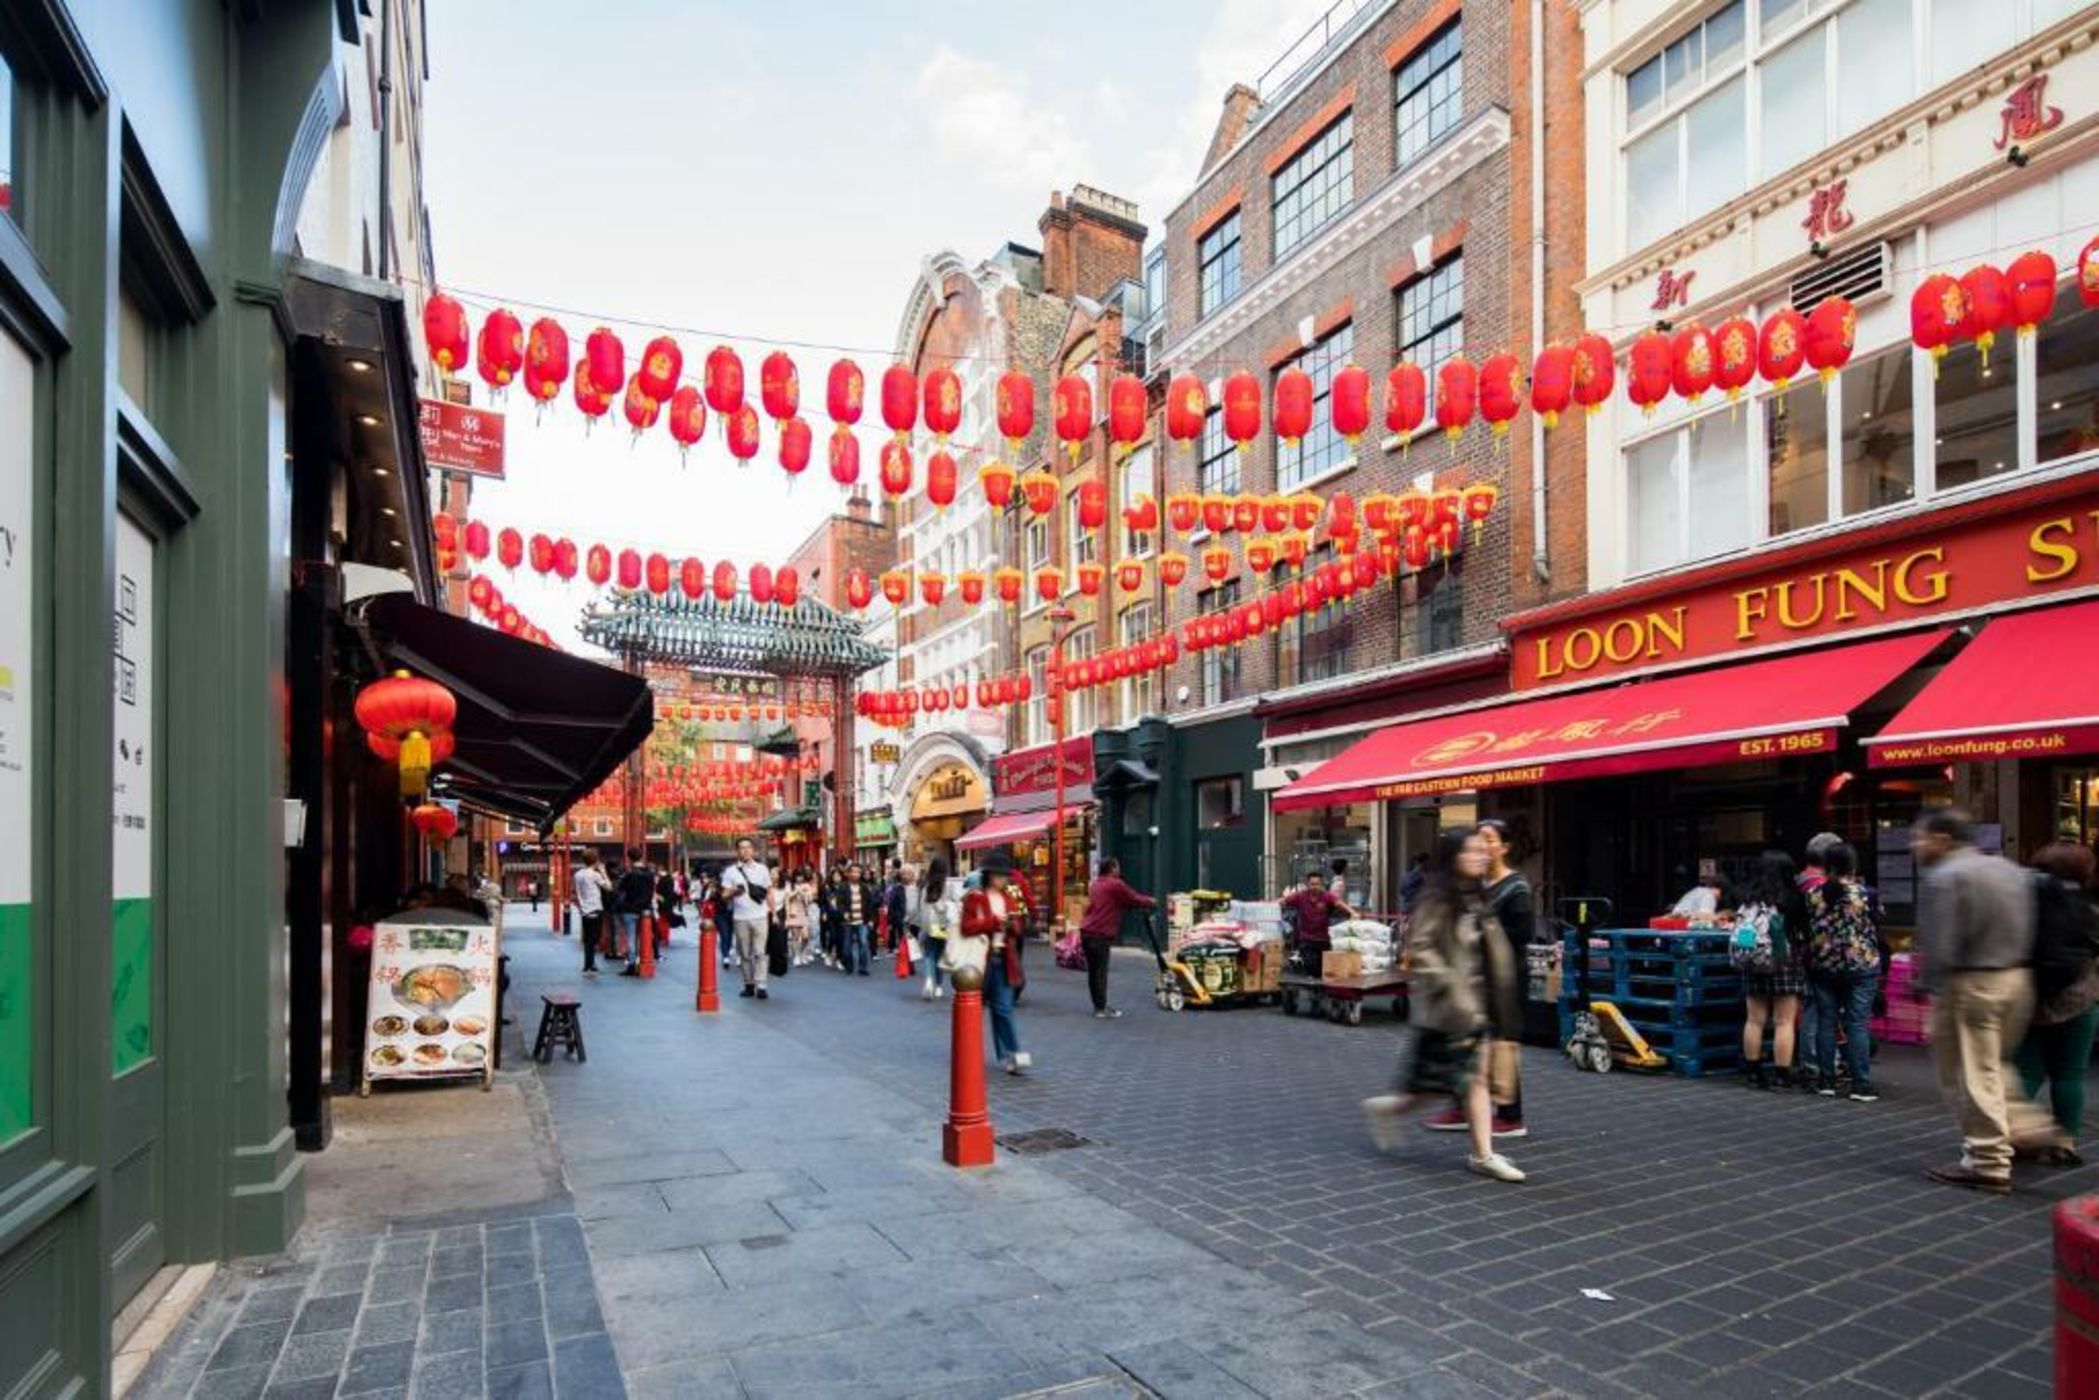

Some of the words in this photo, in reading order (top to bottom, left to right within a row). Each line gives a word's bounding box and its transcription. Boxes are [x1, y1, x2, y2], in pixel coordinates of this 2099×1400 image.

[1536, 607, 1687, 680] LOON
[1733, 546, 1954, 641] FUNG
[2025, 509, 2099, 583] S
[1740, 737, 1774, 755] EST.
[1779, 732, 1824, 750] 1965
[1883, 733, 2065, 761] www.loonfung.co.uk
[1376, 786, 1393, 798] THE
[1414, 777, 1460, 794] EASTERN
[1462, 773, 1494, 789] FOOD
[1496, 766, 1546, 784] MARKET
